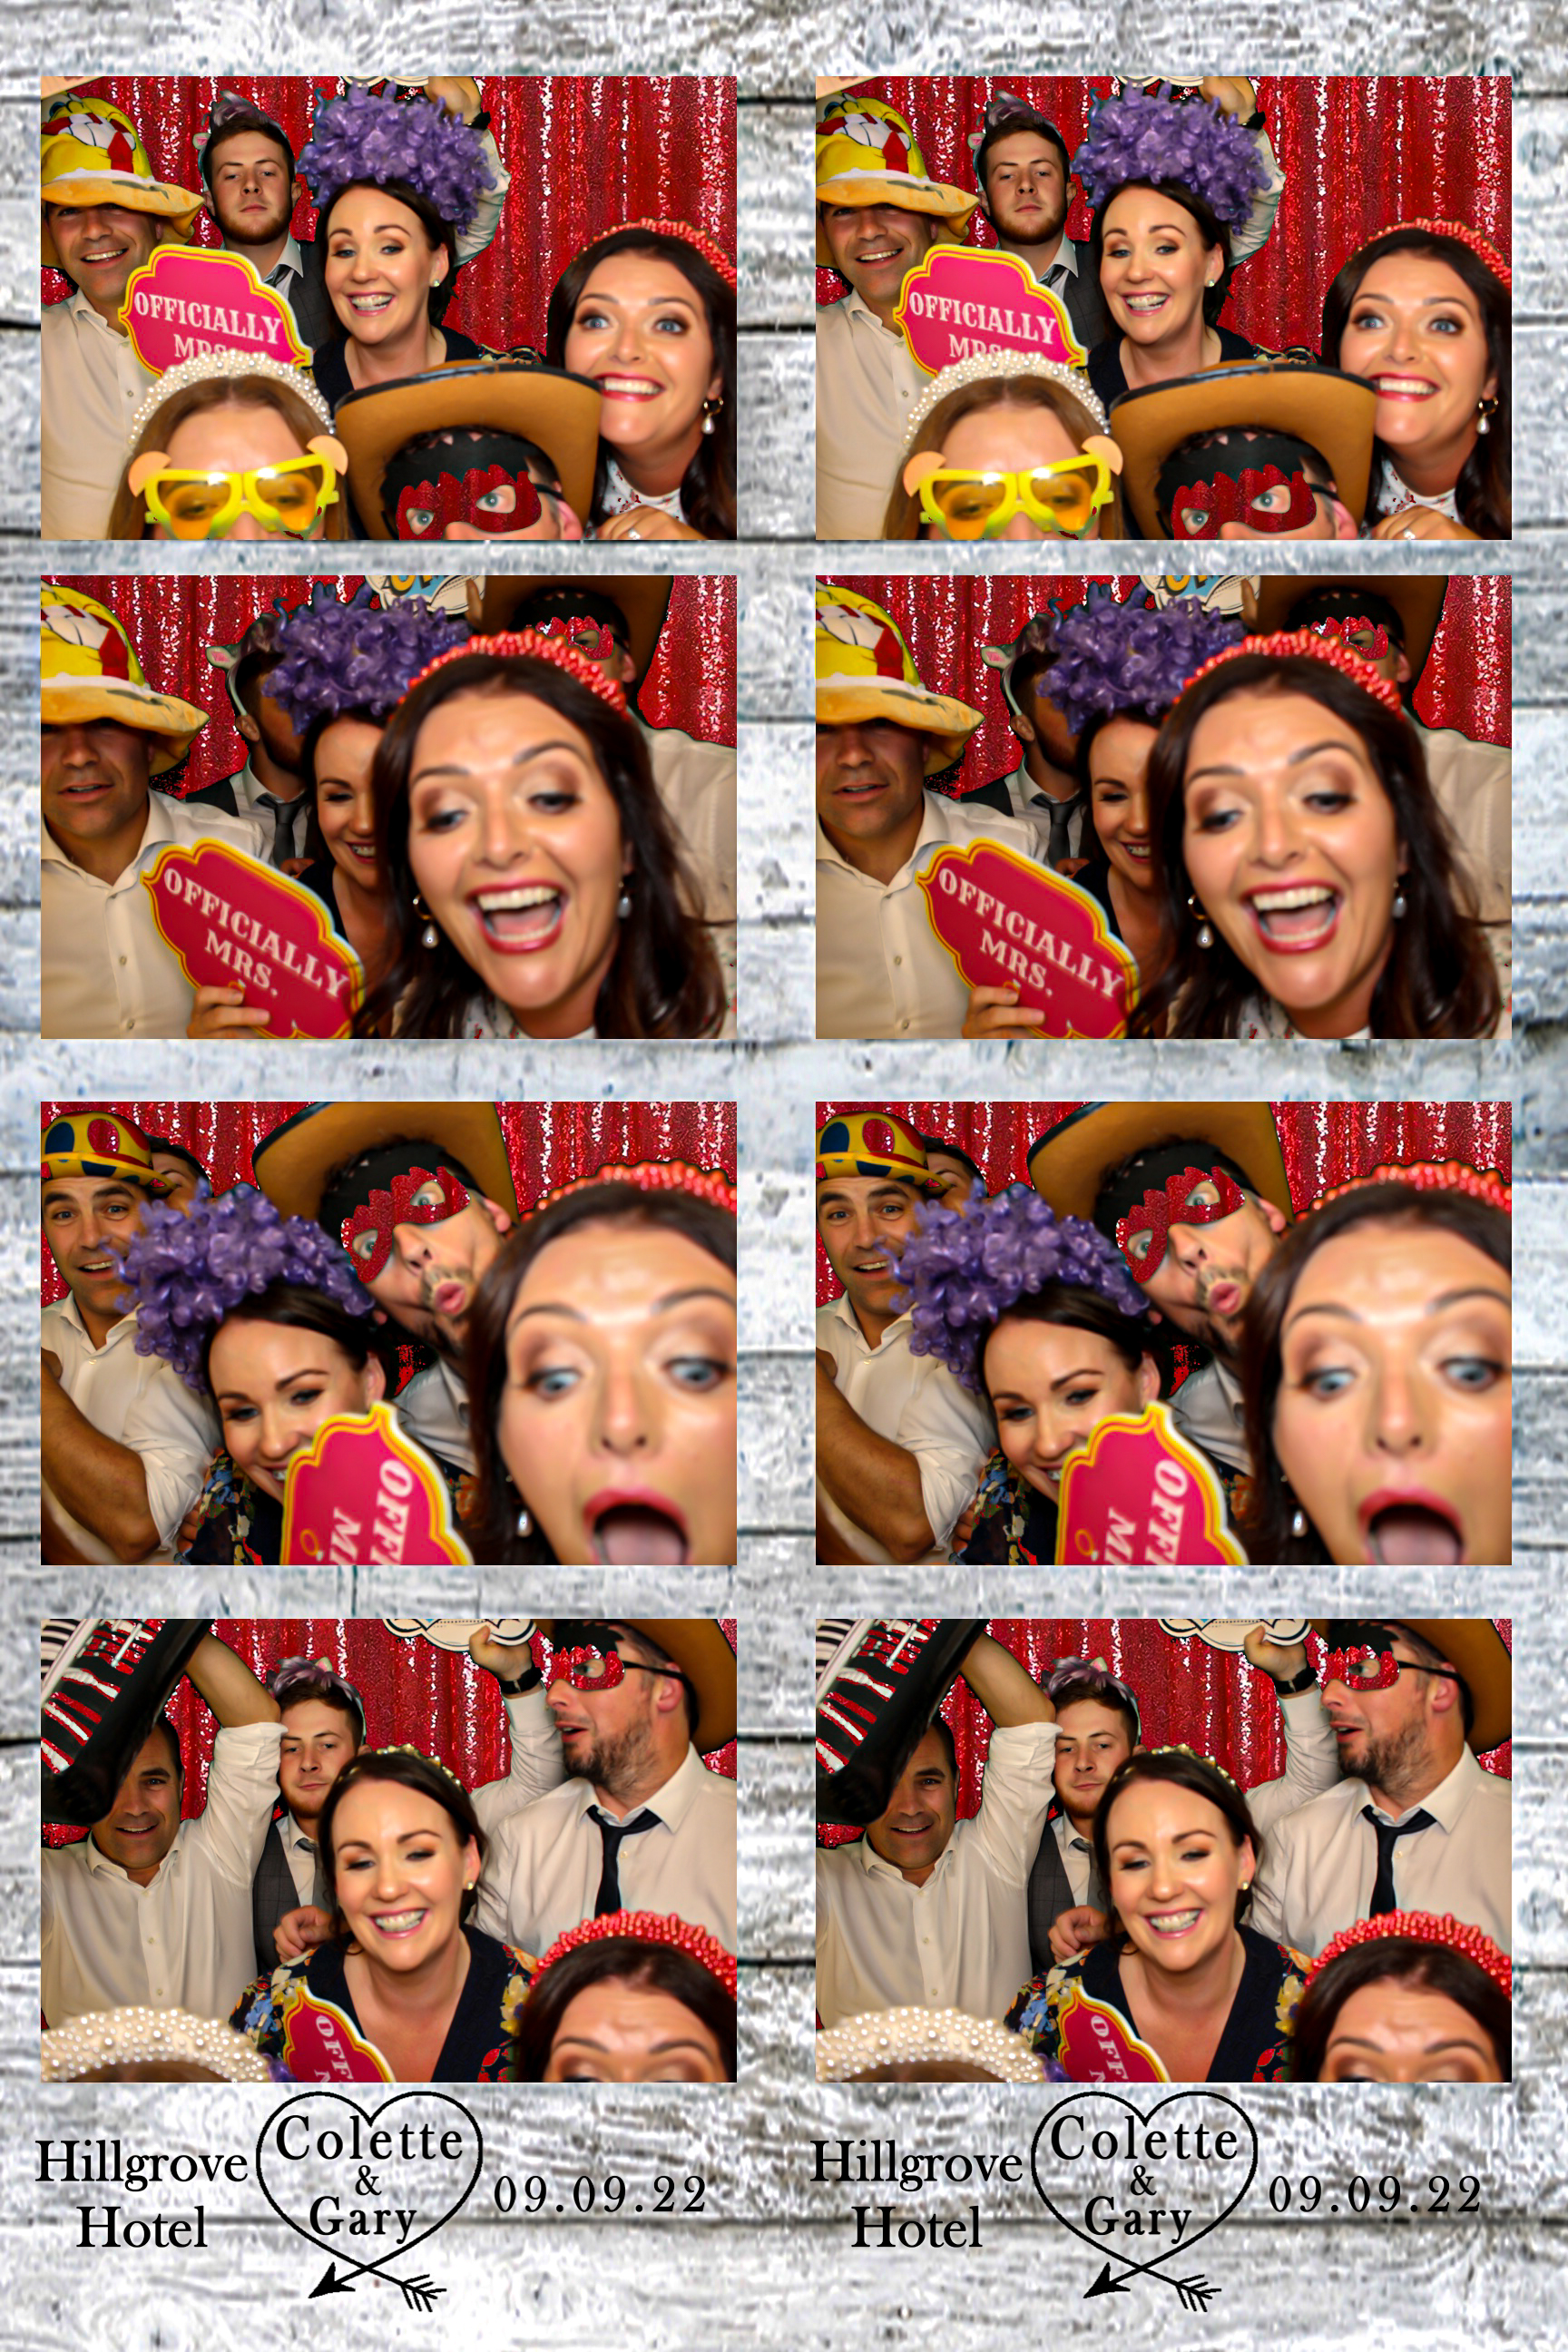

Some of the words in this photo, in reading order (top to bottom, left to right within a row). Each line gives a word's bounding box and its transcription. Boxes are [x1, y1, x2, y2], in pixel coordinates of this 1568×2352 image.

[134, 291, 282, 344] OFFICIALLY
[909, 291, 1057, 344] OFFICIALLY
[163, 867, 349, 998] OFFICIALLY
[204, 928, 279, 997] MRS.
[938, 867, 1124, 998] OFFICIALLY
[979, 928, 1054, 997] MRS.
